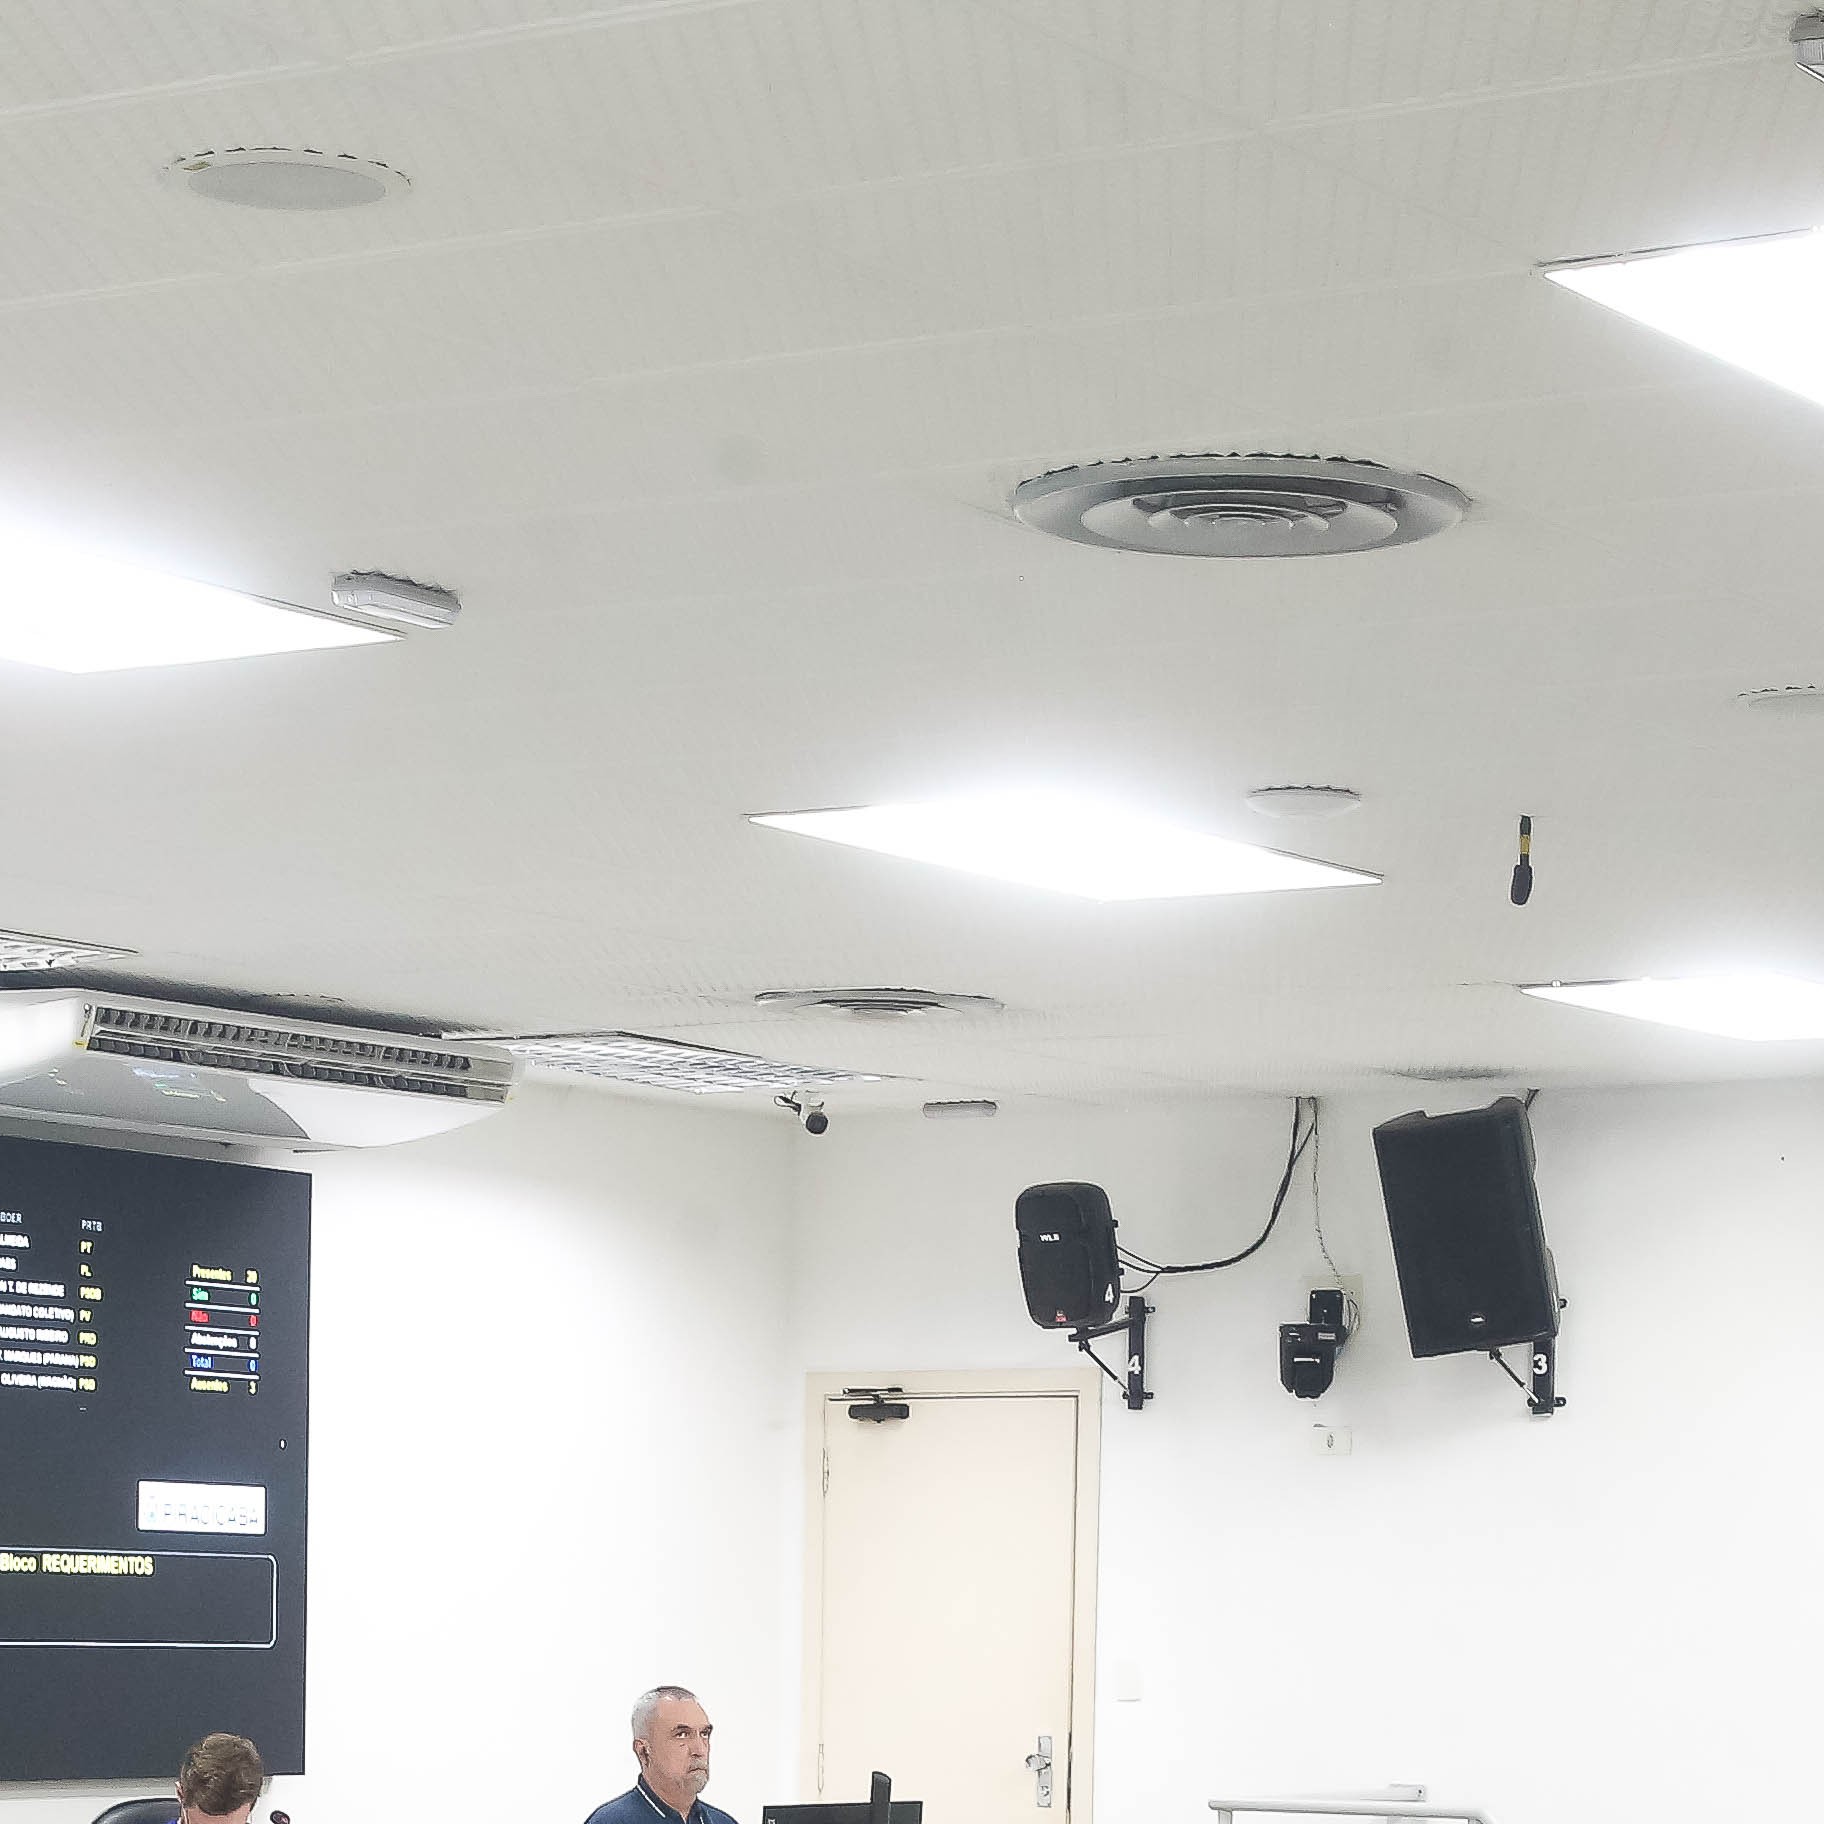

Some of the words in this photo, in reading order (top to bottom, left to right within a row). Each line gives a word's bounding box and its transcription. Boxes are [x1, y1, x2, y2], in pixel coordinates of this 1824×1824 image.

[1105, 1284, 1113, 1303] 4
[192, 1355, 211, 1368] Total
[1128, 1355, 1141, 1374] 4
[1533, 1354, 1547, 1374] 3
[0, 1553, 36, 1571] Bloco
[42, 1553, 153, 1575] REQUERIMENTOS
